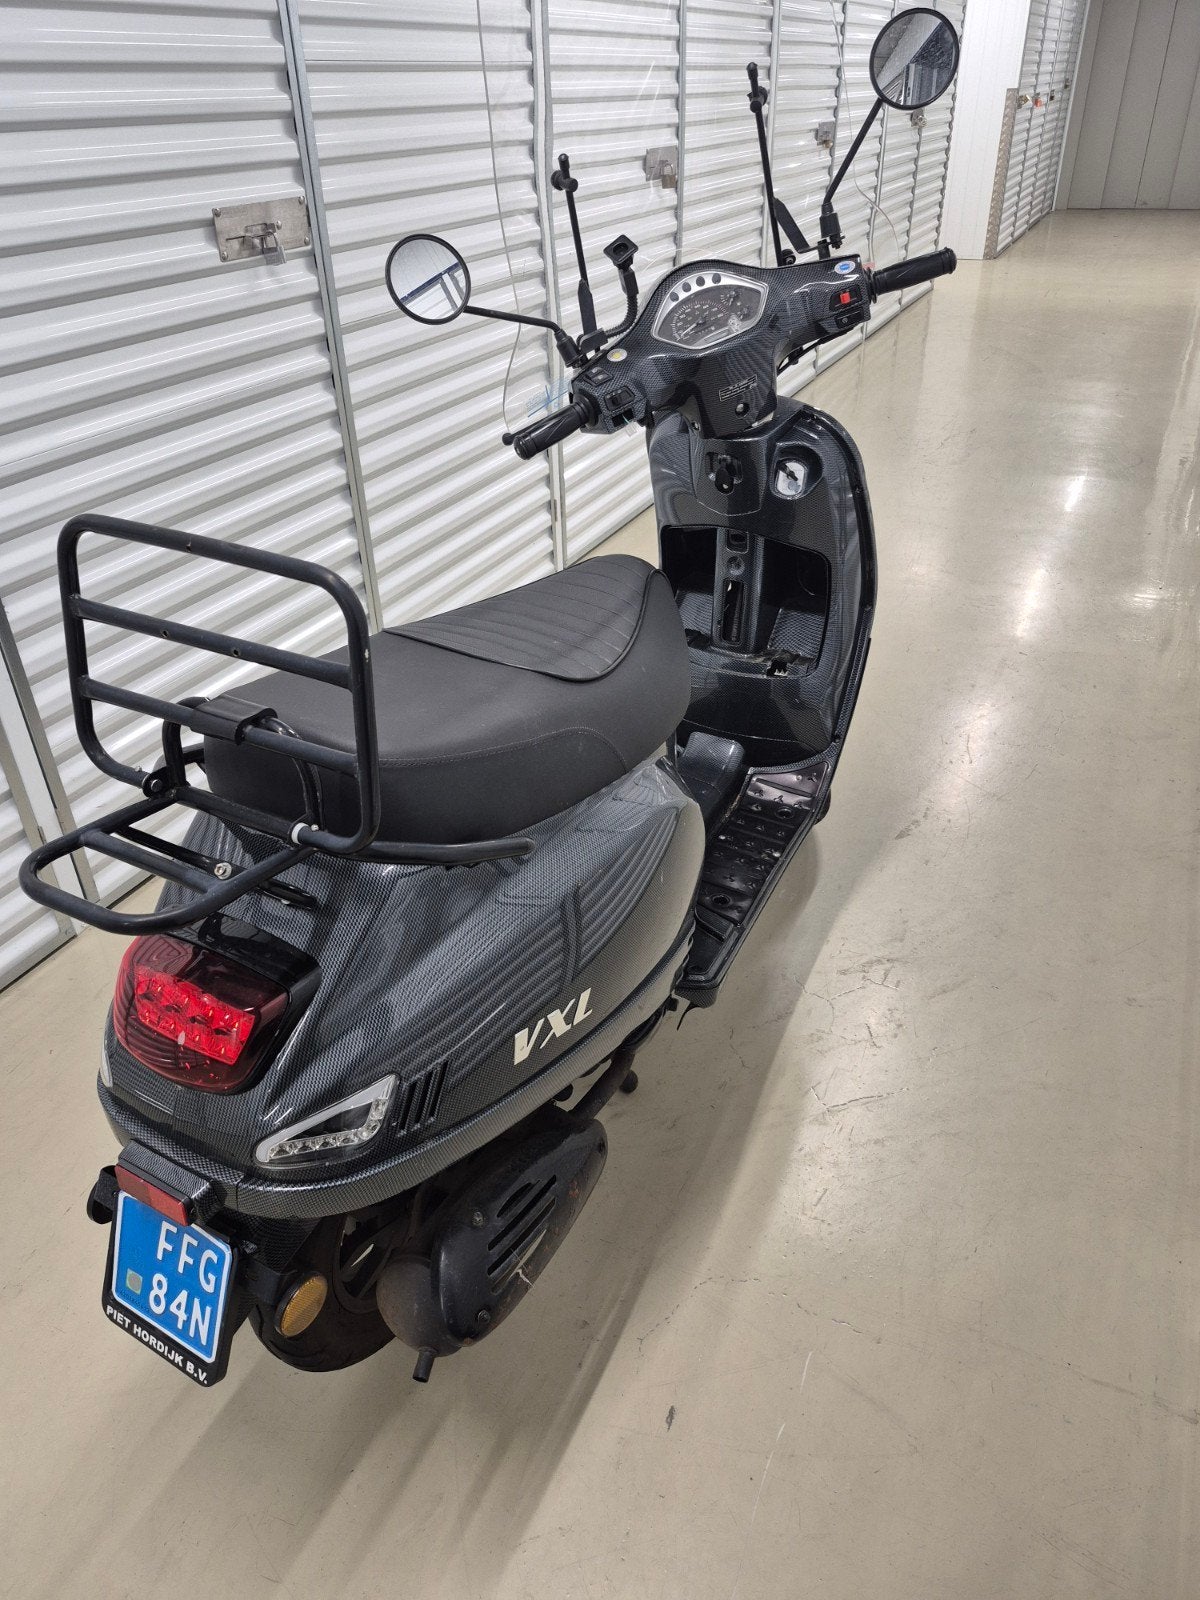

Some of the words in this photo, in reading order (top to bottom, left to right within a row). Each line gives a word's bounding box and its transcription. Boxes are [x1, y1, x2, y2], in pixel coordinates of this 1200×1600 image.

[513, 987, 593, 1066] VXL
[156, 1220, 218, 1293] FFG
[106, 1305, 131, 1329] PIET
[133, 1323, 184, 1367] HORDIJK
[185, 1360, 208, 1385] B.V.
[148, 1273, 211, 1346] 84N
